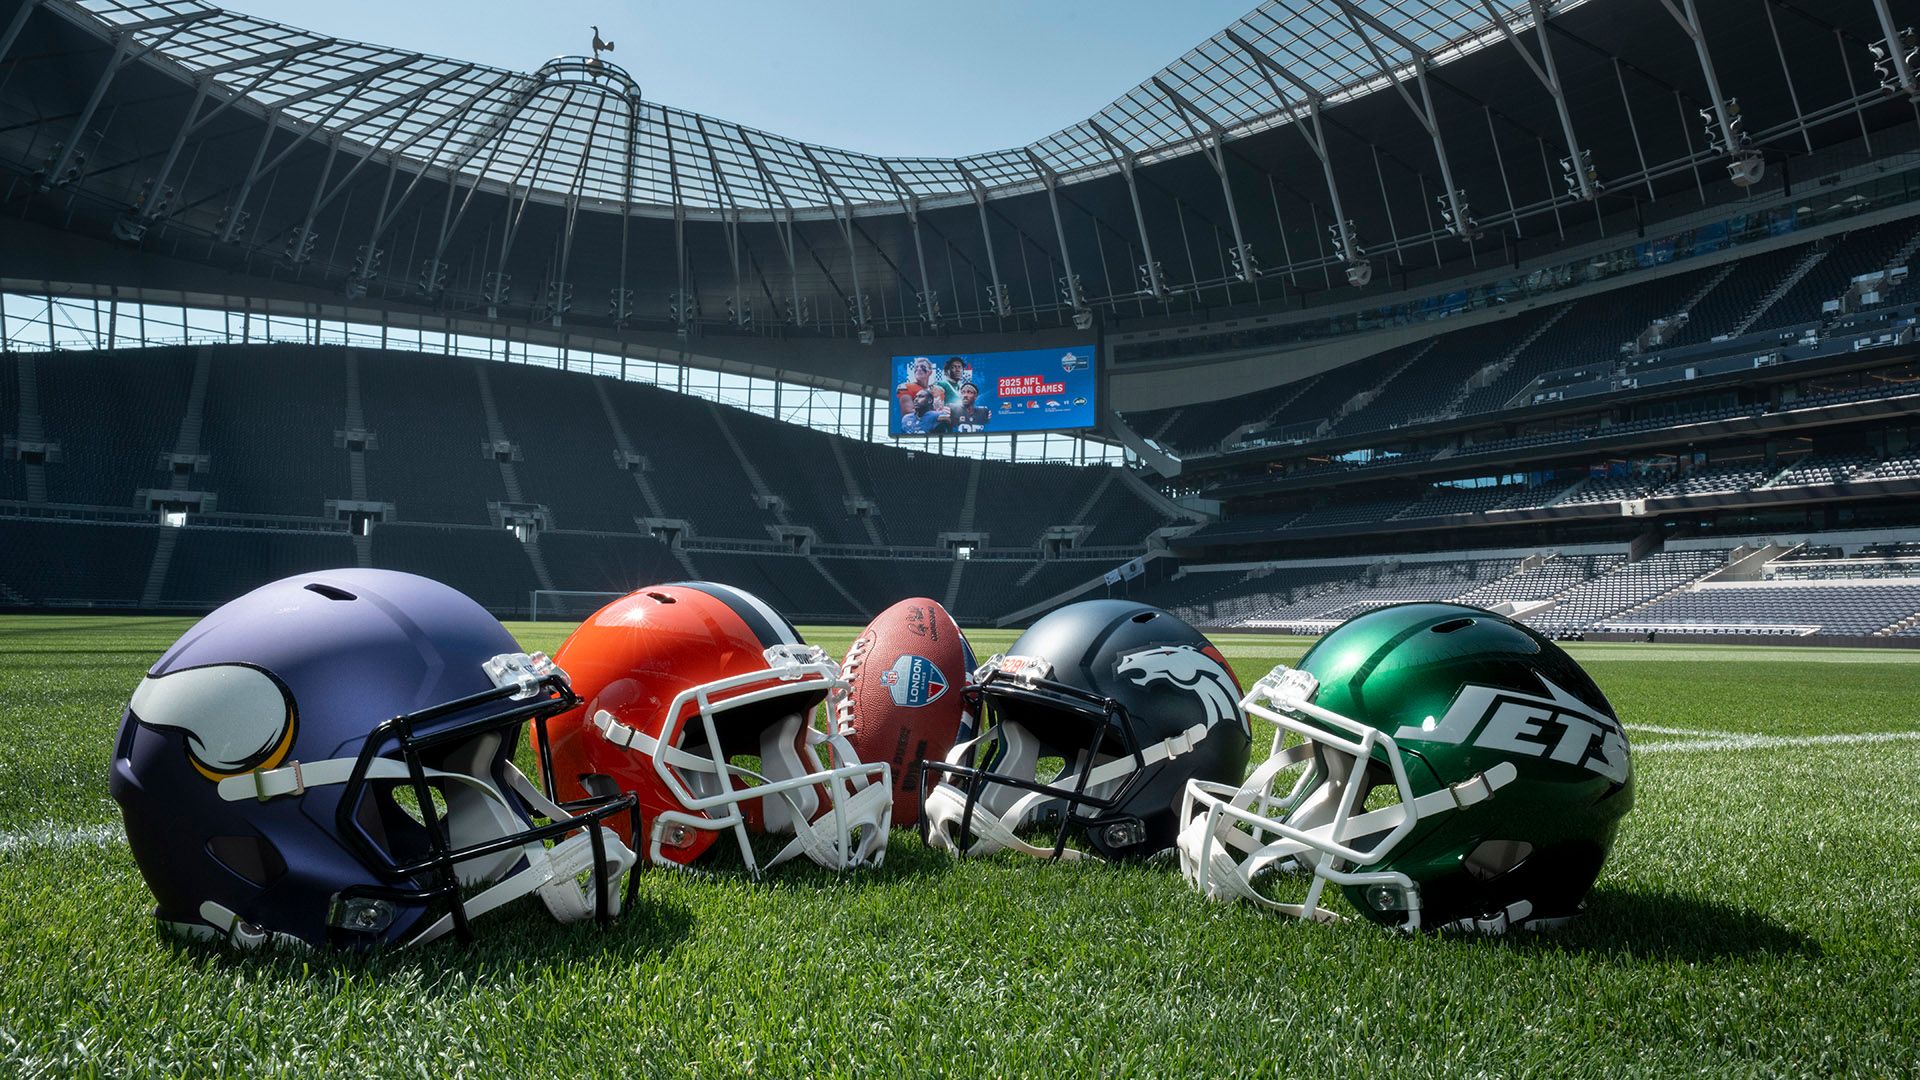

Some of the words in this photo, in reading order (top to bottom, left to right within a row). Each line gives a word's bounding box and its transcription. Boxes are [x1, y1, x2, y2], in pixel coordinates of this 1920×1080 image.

[999, 378, 1021, 387] 2025
[1024, 377, 1040, 386] NFL
[999, 386, 1033, 396] LONDON
[1035, 384, 1063, 394] GAMES
[909, 658, 923, 703] LONDON
[1394, 668, 1630, 785] JETS
